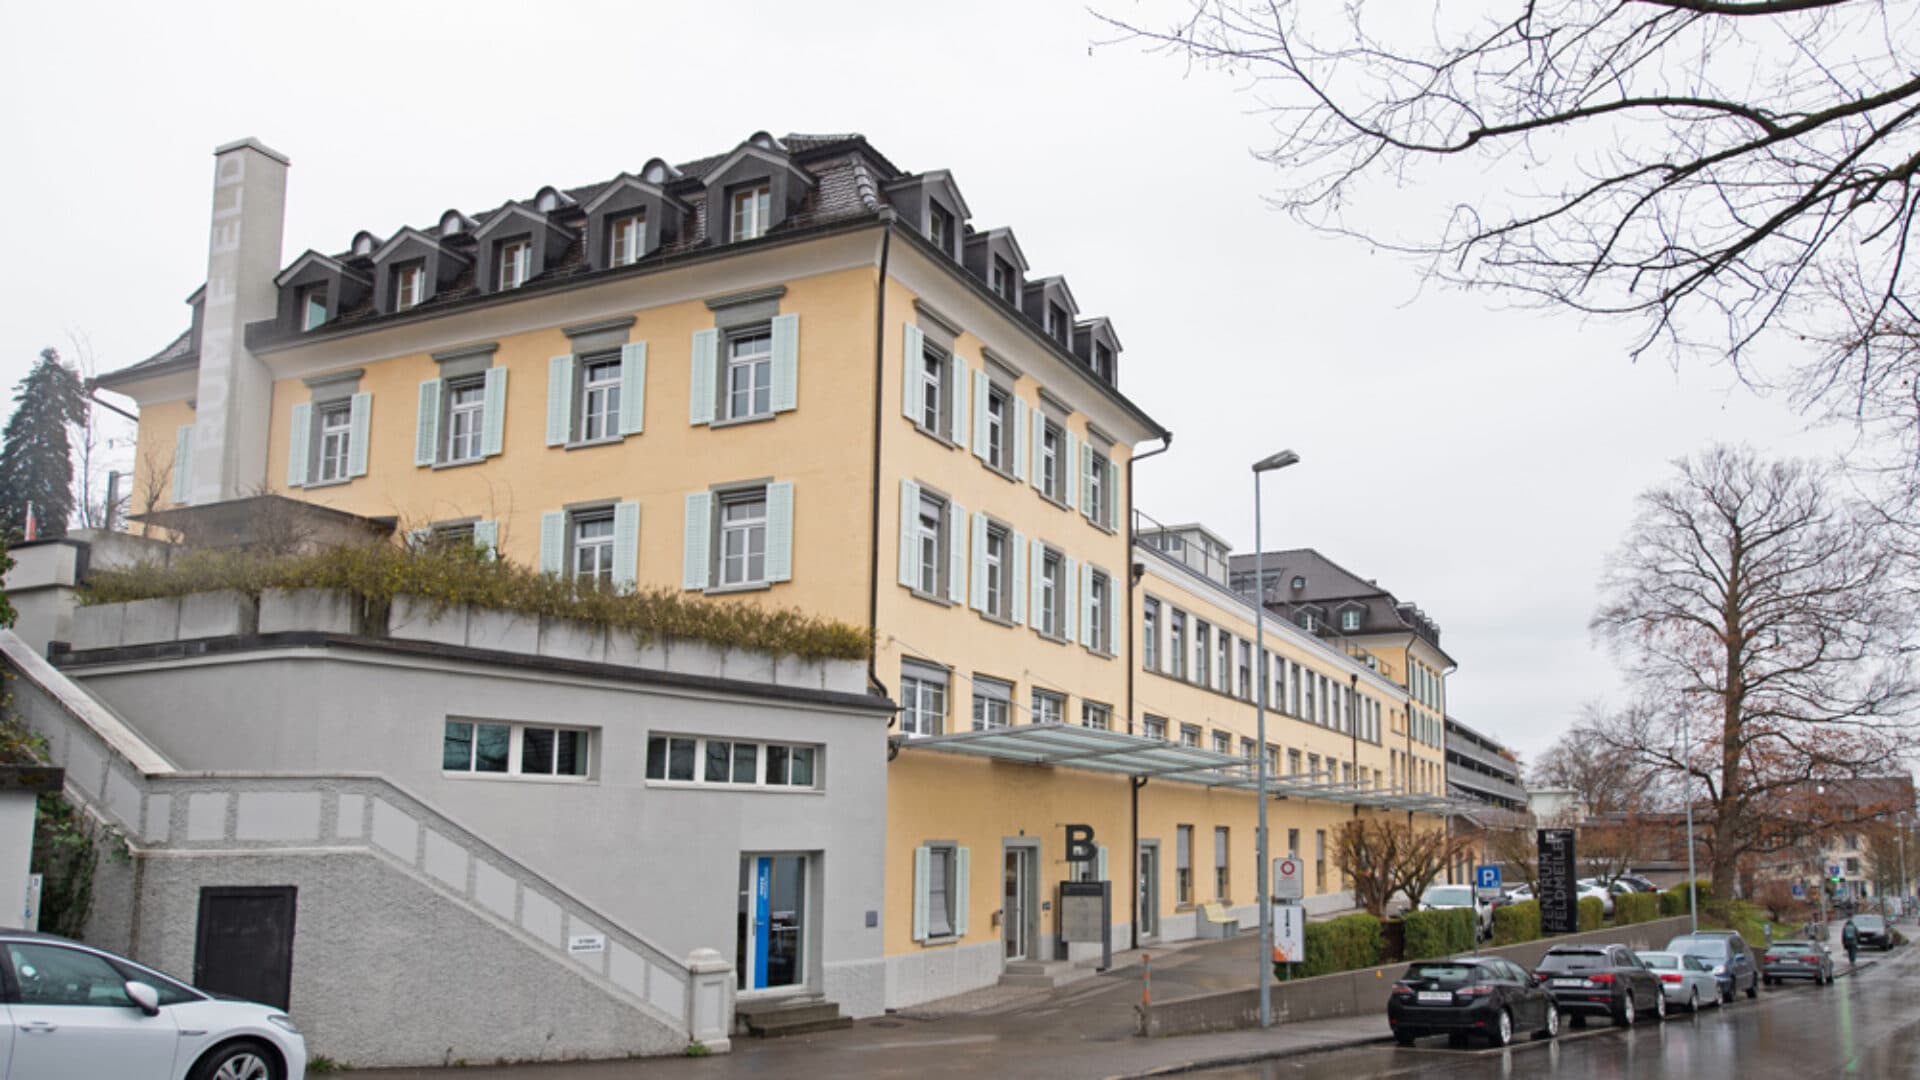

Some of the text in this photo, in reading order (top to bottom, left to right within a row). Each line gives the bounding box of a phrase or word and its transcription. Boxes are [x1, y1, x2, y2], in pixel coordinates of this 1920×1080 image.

[1065, 824, 1098, 862] B
[1482, 869, 1495, 886] P
[1540, 852, 1554, 930] ZENTRUM
